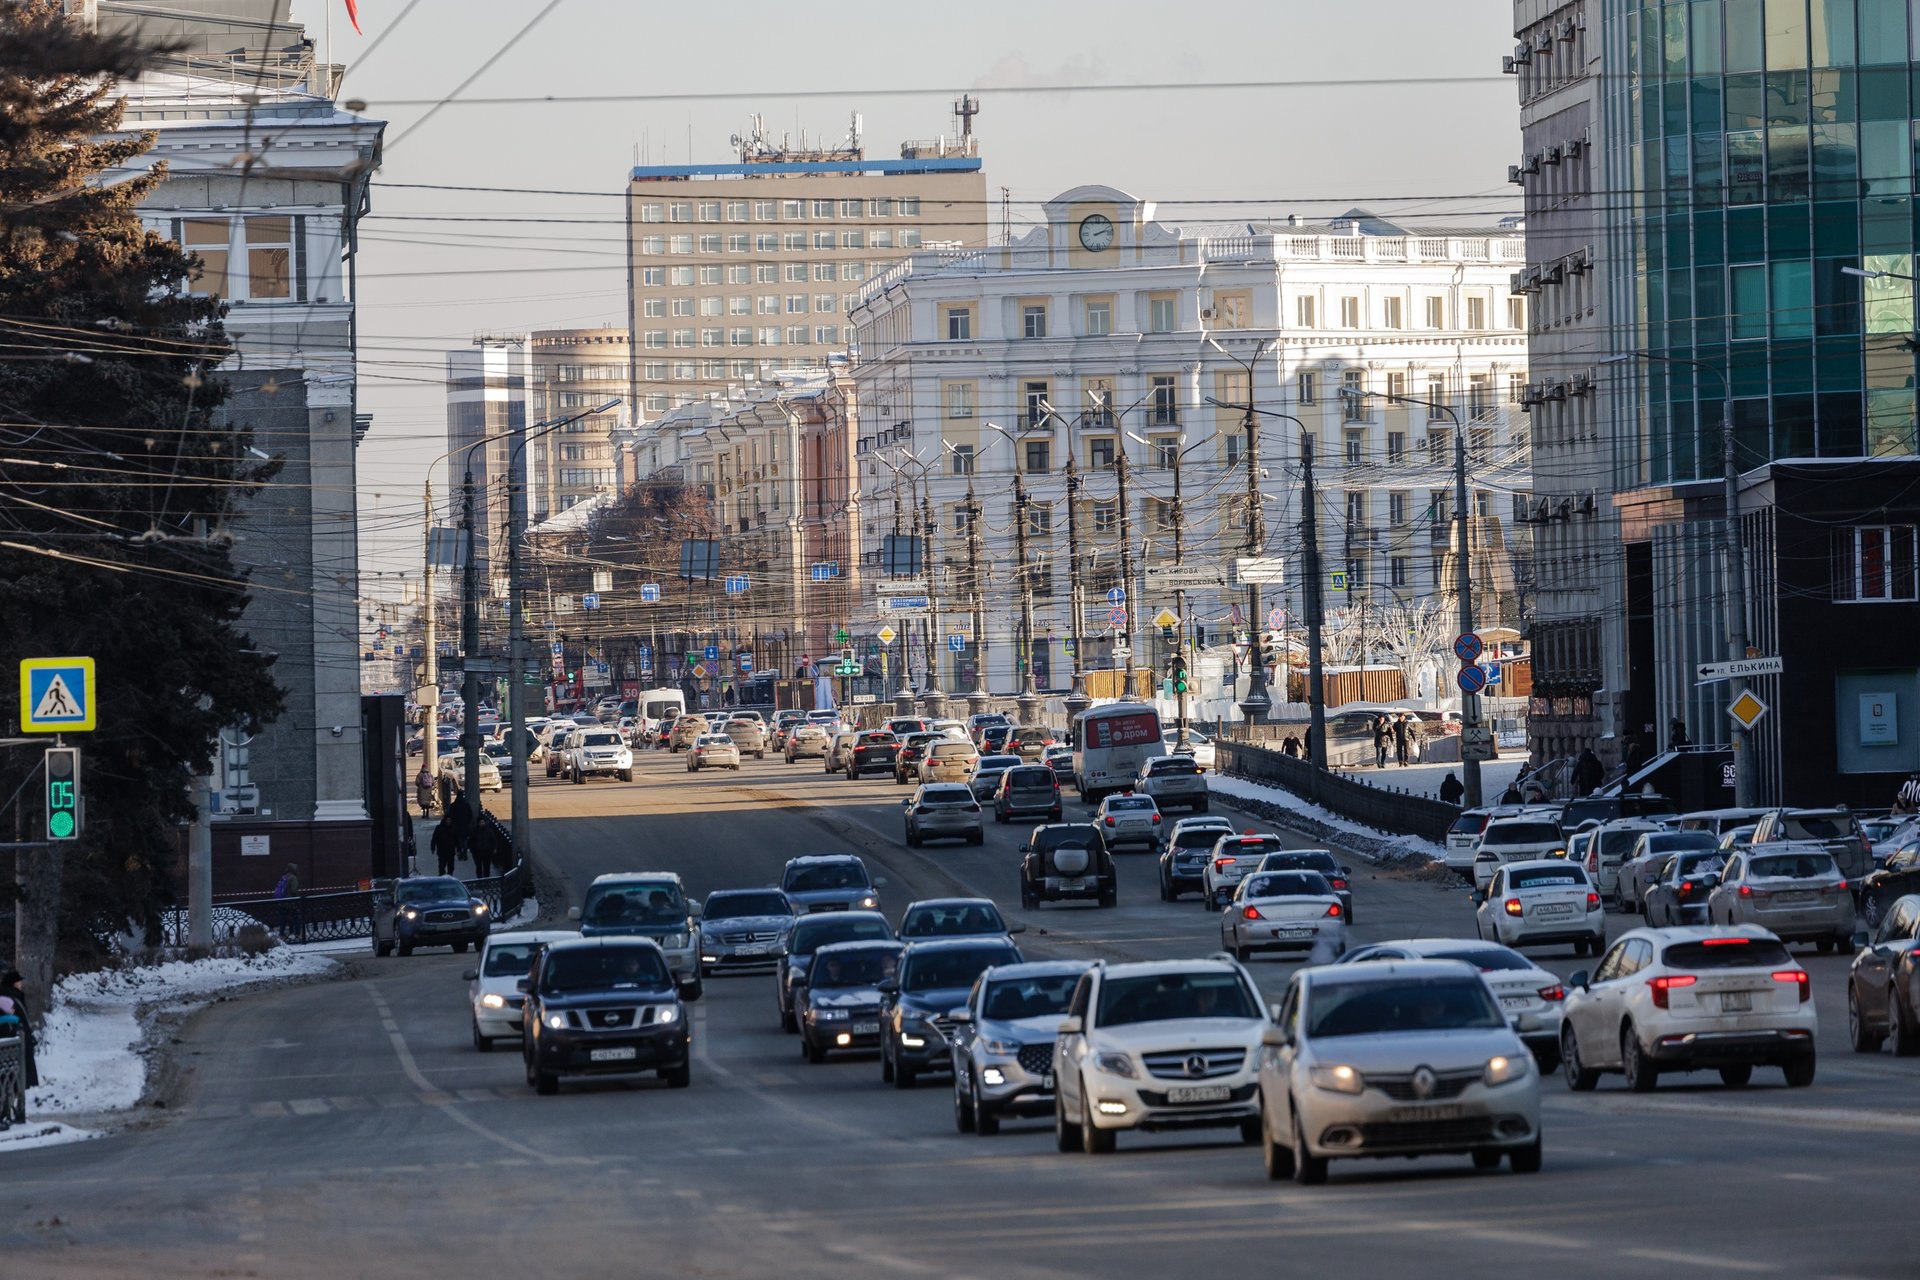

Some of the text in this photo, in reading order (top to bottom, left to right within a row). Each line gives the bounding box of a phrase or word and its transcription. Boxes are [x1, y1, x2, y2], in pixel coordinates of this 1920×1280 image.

[1730, 661, 1780, 673] ЕЛЬКИНА
[624, 688, 638, 698] 30
[1124, 729, 1148, 740] дром
[50, 781, 75, 809] 05
